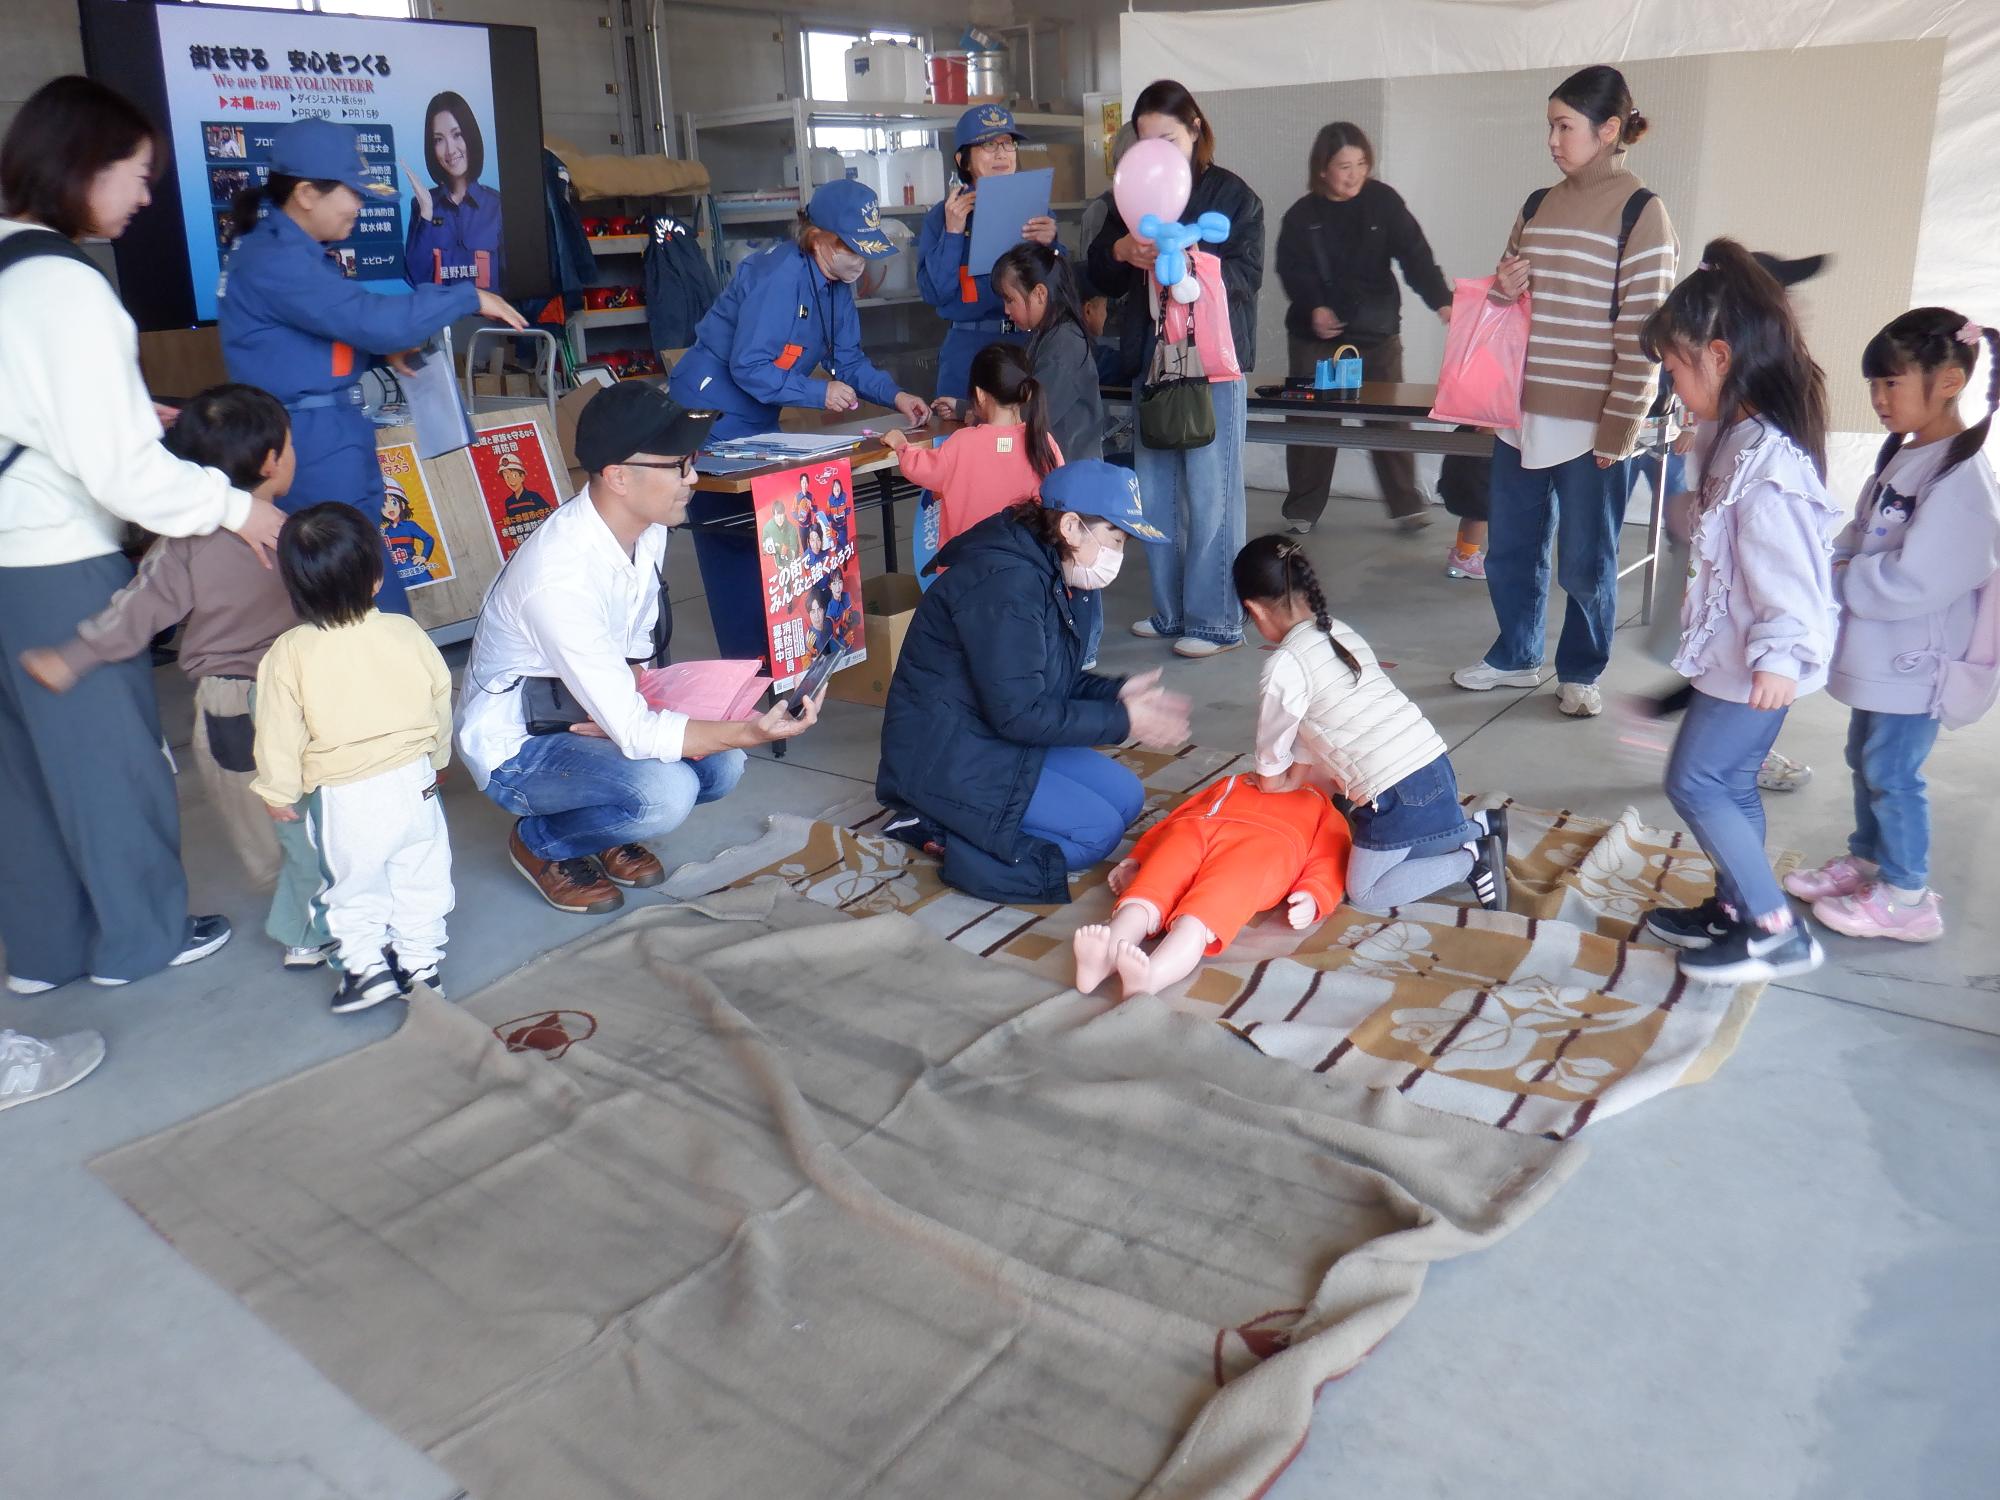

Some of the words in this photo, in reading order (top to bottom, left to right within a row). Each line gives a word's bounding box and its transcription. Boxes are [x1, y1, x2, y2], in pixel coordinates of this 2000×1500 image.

[189, 44, 269, 71] 街を守る
[287, 49, 391, 77] 安心をつくる
[212, 74, 234, 88] We
[238, 77, 257, 89] are
[259, 75, 293, 91] FIRE
[294, 77, 375, 94] VOLUNTEER
[360, 222, 392, 233] 放水体験
[440, 265, 479, 280] 星野真里
[492, 441, 519, 455] 消防団
[383, 463, 410, 476] 守ろう
[768, 554, 811, 595] この街で
[772, 624, 785, 664] 募集中
[781, 621, 795, 674] 消防団員
